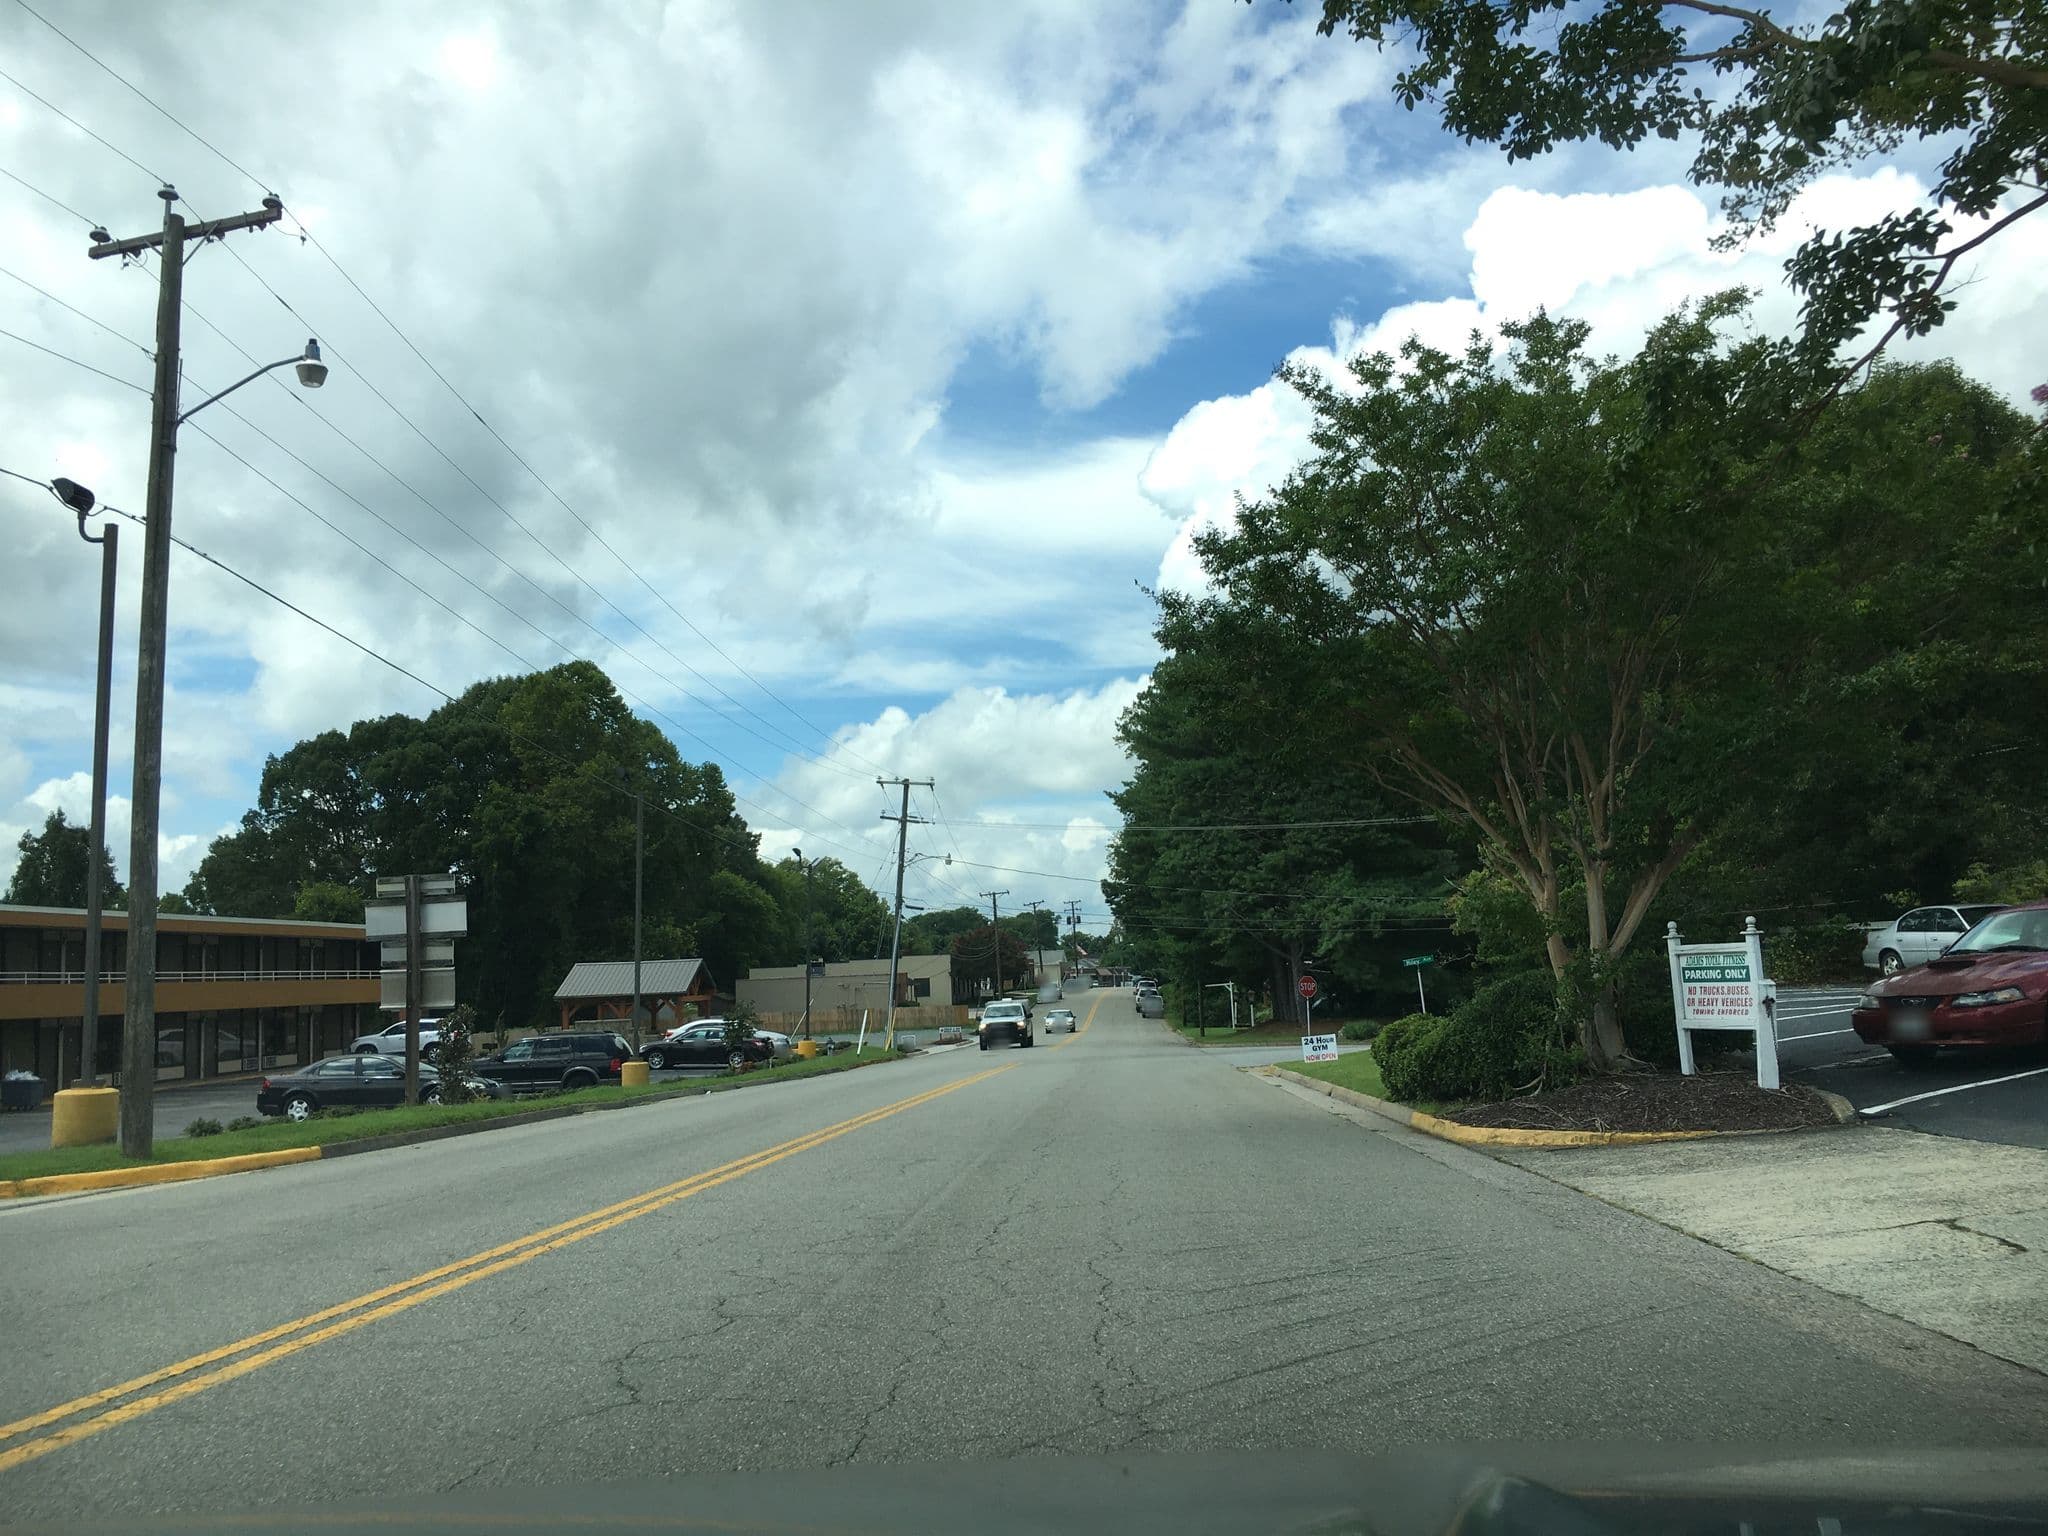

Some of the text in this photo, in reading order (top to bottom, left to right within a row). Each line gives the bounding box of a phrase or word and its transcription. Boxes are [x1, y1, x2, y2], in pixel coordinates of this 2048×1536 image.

[1722, 955, 1746, 965] FITNESS
[1684, 969, 1747, 979] PARKING ONLY
[1300, 982, 1316, 990] STOP
[1688, 986, 1696, 996] NO
[1687, 998, 1753, 1006] OR HEAVY VEHICLES
